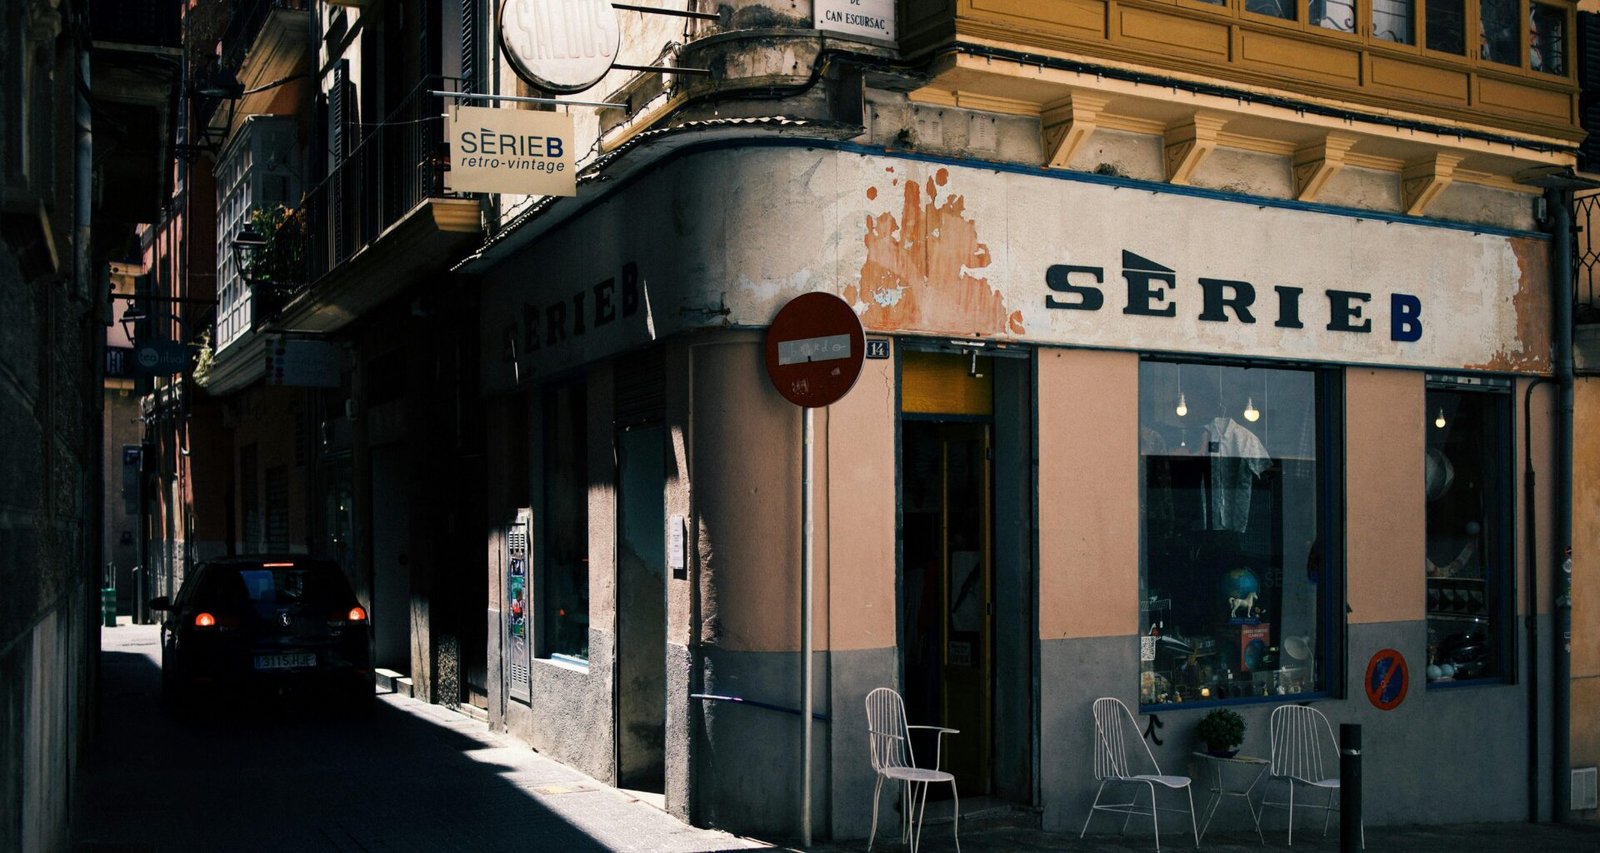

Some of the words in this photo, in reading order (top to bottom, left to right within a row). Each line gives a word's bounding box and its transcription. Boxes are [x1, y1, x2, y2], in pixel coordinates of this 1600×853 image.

[825, 10, 843, 22] CAN
[845, 13, 885, 29] ESCURSAC
[461, 156, 565, 174] retro-vintage
[870, 342, 885, 356] 14
